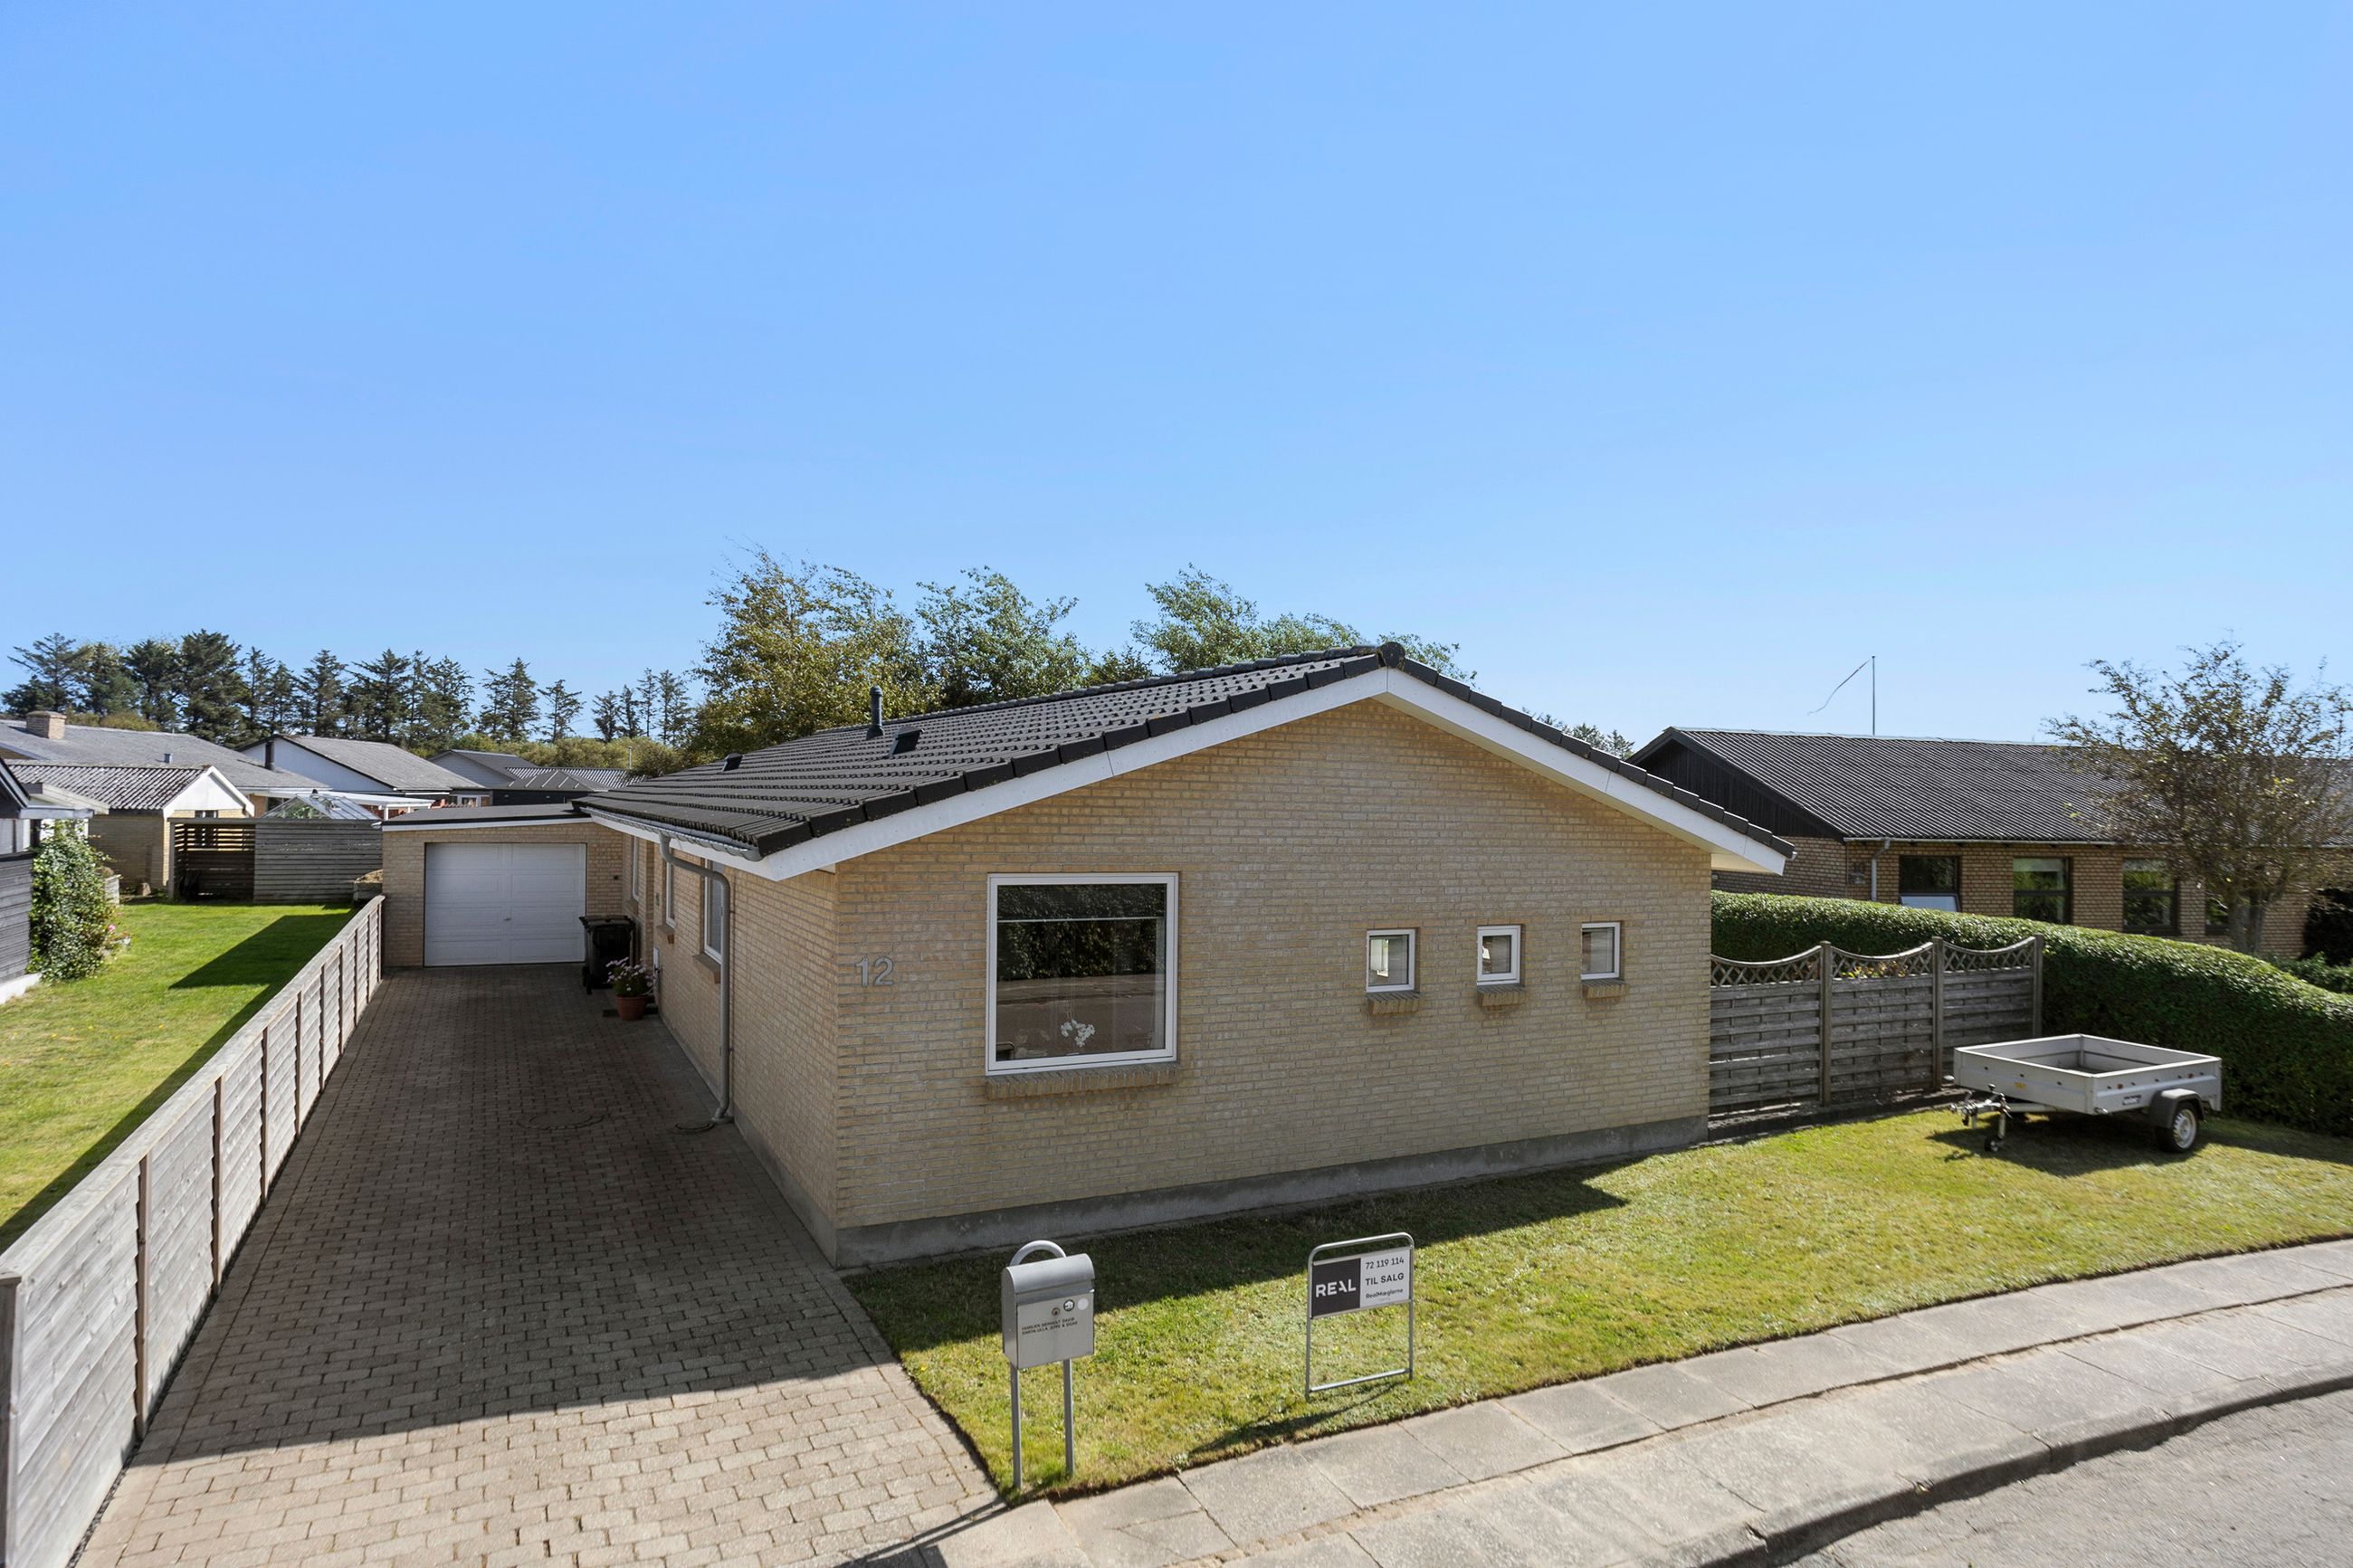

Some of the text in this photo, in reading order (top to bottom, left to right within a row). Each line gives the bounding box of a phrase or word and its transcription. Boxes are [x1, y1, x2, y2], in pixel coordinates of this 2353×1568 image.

[854, 955, 894, 988] 12
[1365, 1257, 1405, 1269] 72 119 114
[1365, 1272, 1405, 1286] TIL SALG
[1315, 1278, 1357, 1298] REAL
